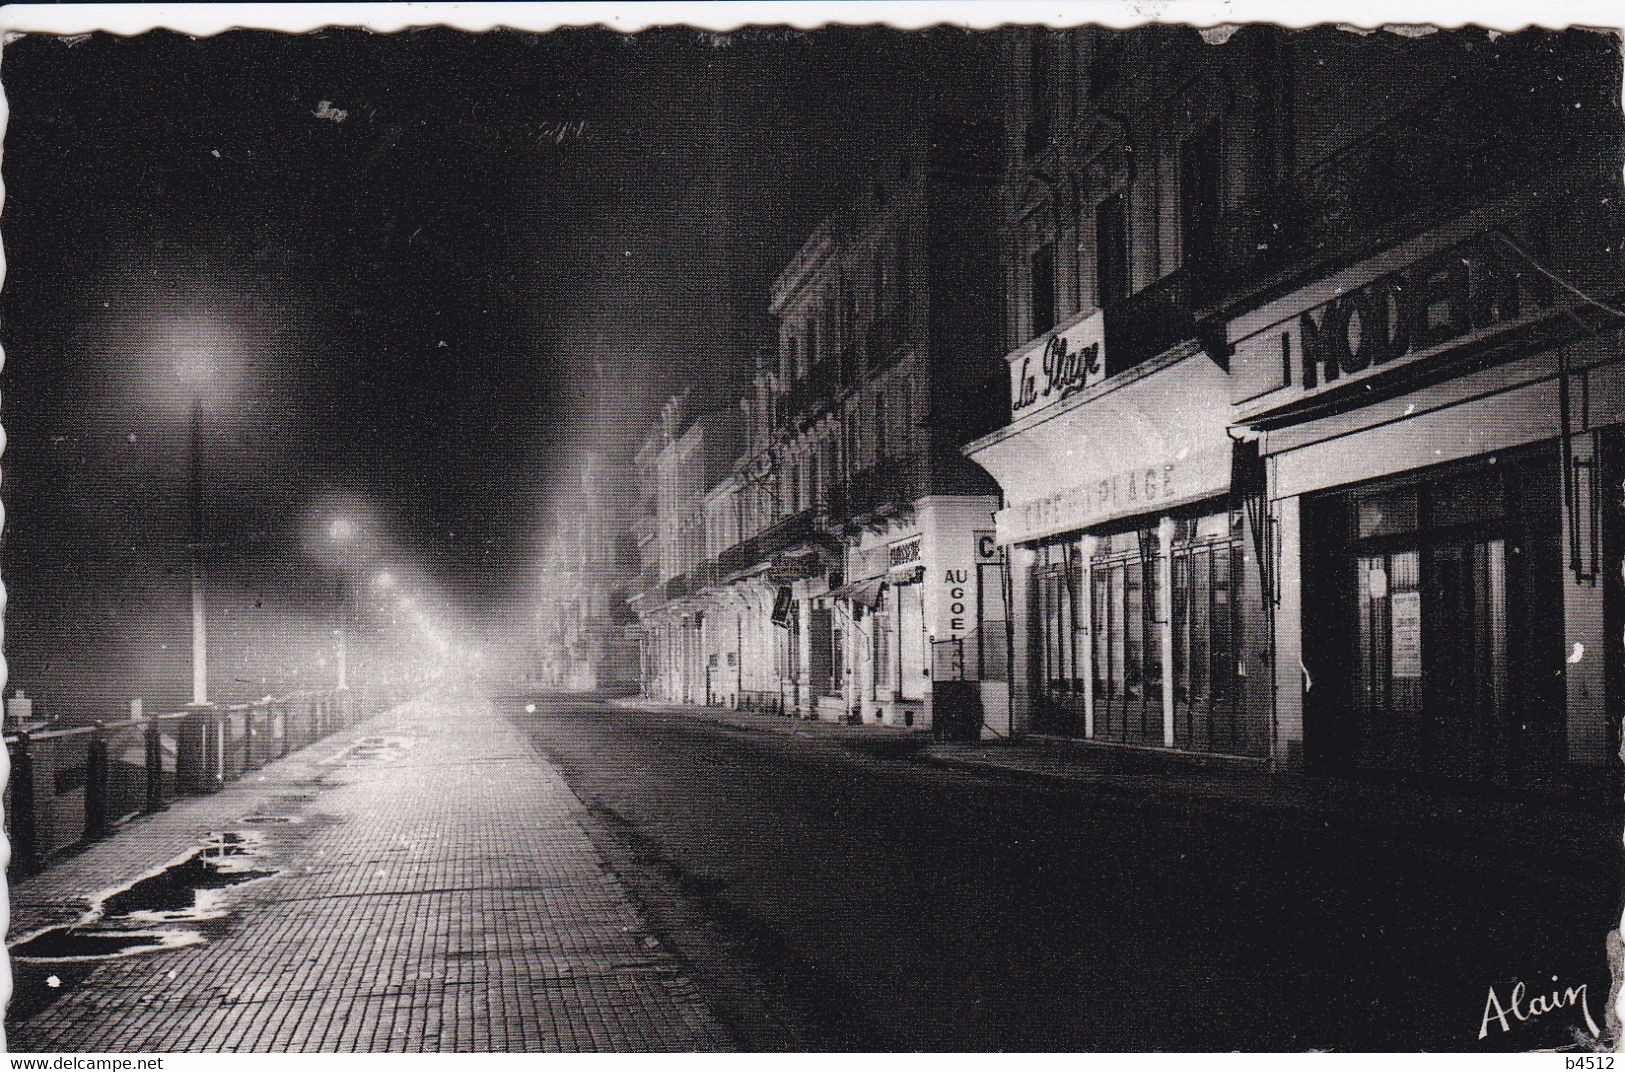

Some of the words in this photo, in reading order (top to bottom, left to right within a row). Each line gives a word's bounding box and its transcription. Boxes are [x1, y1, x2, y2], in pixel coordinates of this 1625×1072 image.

[1013, 357, 1037, 410] La
[1042, 334, 1100, 400] Plage
[945, 569, 968, 584] AU
